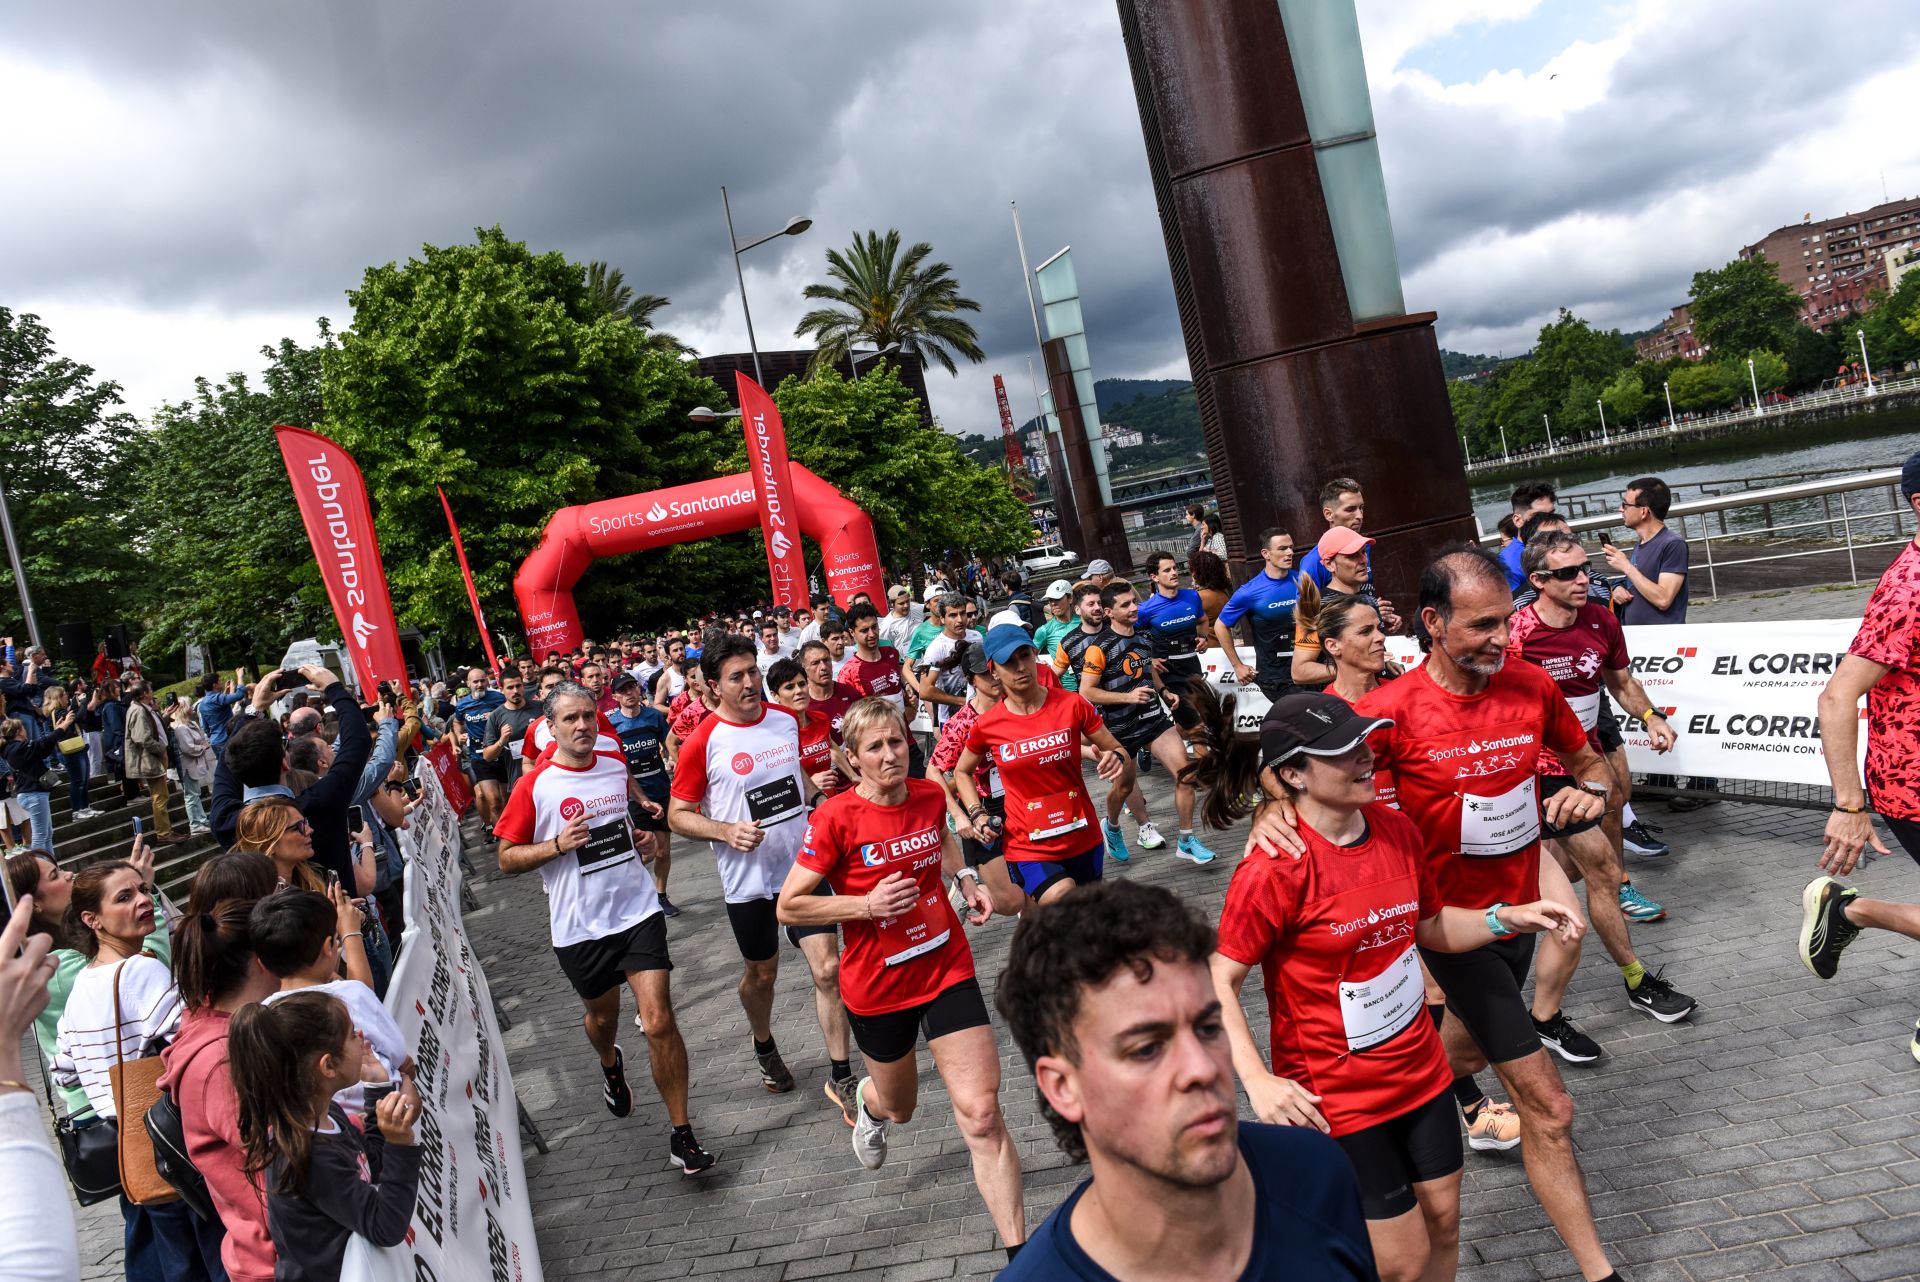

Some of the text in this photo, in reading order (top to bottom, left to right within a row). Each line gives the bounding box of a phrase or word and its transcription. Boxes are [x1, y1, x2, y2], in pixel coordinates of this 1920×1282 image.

[589, 489, 756, 536] Sports Santander
[647, 520, 705, 537] sportssantander.es
[833, 552, 860, 564] Sports
[834, 563, 873, 577] Santander
[527, 611, 553, 623] Sports
[1160, 614, 1196, 627] ORBEA
[529, 620, 568, 636] Santander
[1630, 656, 1684, 674] REO
[1711, 655, 1743, 675] EL
[1219, 672, 1235, 683] EL
[1688, 714, 1721, 735] EL
[802, 741, 829, 756] EROSKI
[1019, 732, 1069, 754] EROSKI
[1428, 733, 1534, 763] Sports Santander
[1721, 740, 1792, 754] INFORMACIÓN
[1793, 745, 1816, 755] CON
[1038, 749, 1072, 765] zurekin
[1522, 783, 1532, 795] 753
[1483, 814, 1505, 822] BANCO
[1505, 802, 1528, 819] SANTANDER
[1506, 821, 1526, 836] ANTONIO
[890, 829, 939, 857] EROSKI
[1329, 899, 1419, 937] Sports Santande
[905, 923, 927, 936] EROSKI
[910, 931, 927, 942] PILAR
[1402, 953, 1414, 968] 753
[1362, 995, 1385, 1010] BANCO
[1384, 975, 1409, 1002] SANTANDER
[1382, 1002, 1405, 1020] VANESA
[418, 1106, 444, 1210] CORREO
[417, 1194, 443, 1250] EL
